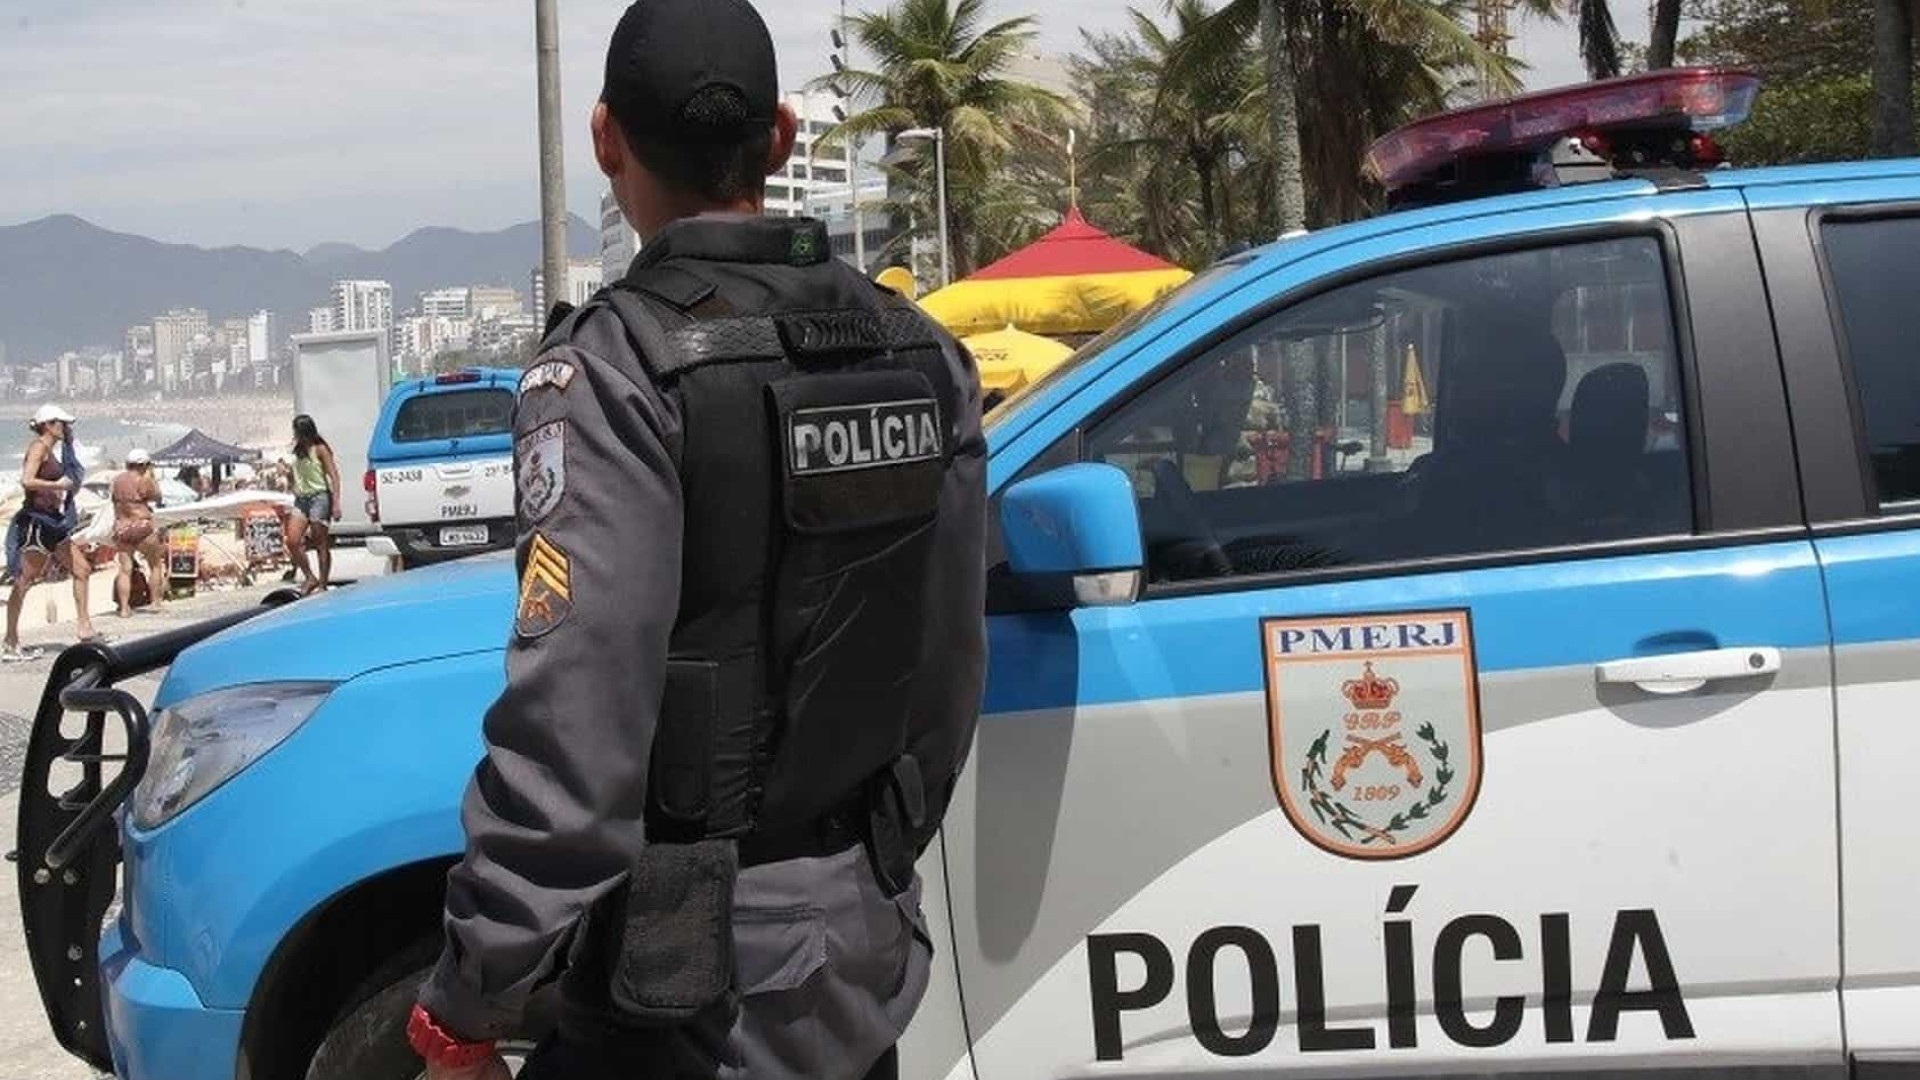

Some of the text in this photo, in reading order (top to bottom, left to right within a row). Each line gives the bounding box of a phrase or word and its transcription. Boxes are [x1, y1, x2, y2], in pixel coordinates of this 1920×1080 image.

[794, 407, 940, 468] POLÍCIA
[1279, 622, 1455, 654] PMERJ
[1353, 784, 1402, 801] 1809
[1086, 884, 1697, 1062] POLÍCIA
